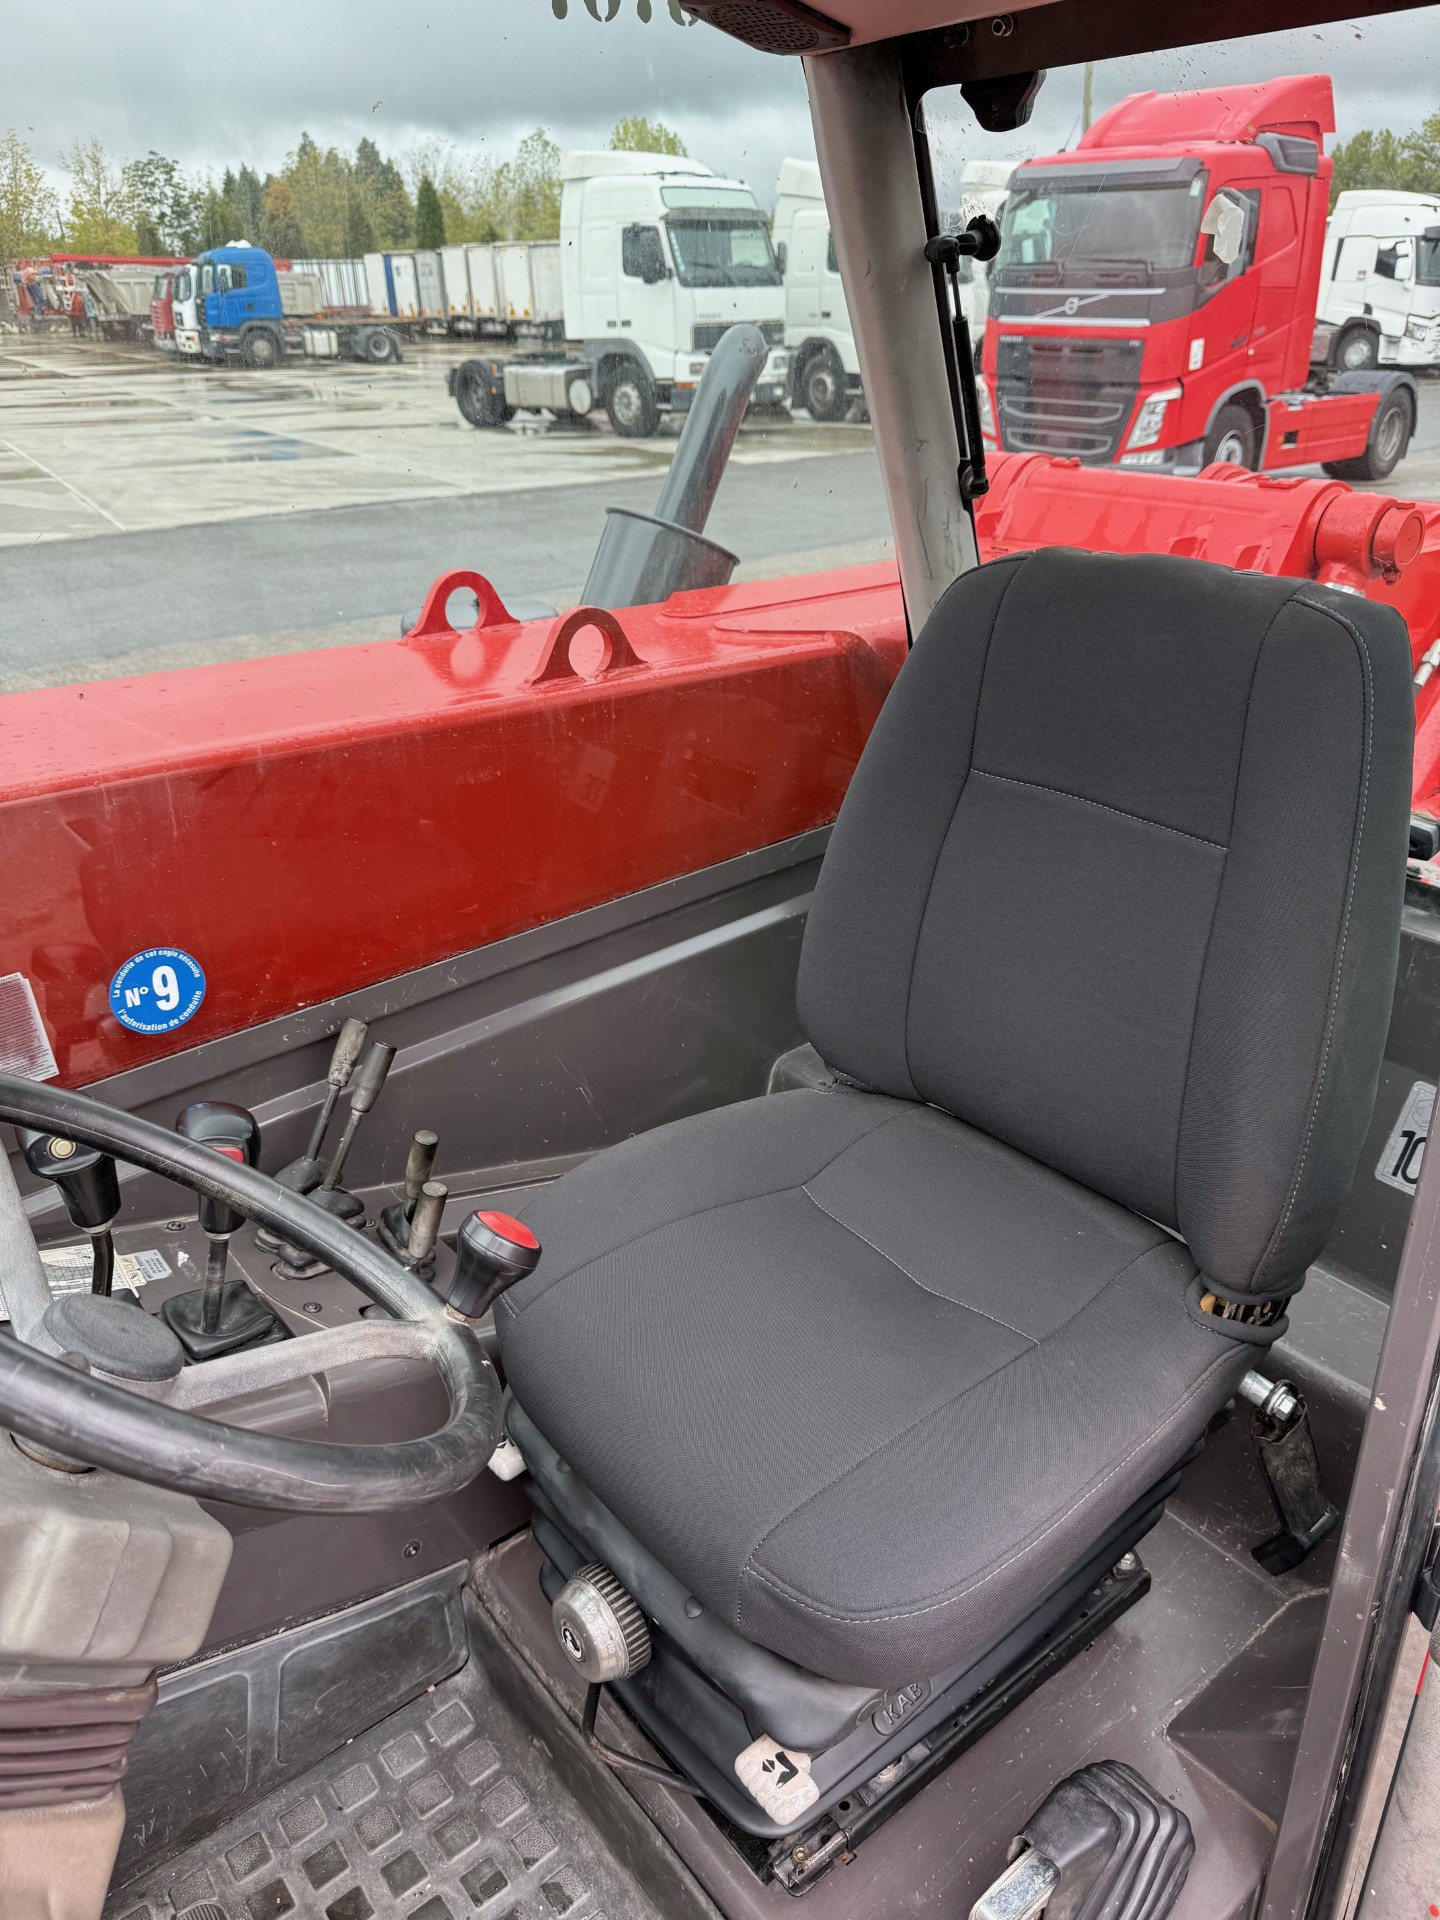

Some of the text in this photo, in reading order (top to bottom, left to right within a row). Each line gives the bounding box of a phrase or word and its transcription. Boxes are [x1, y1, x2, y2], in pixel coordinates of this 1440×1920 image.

[134, 954, 144, 963] de
[145, 950, 157, 958] cet
[158, 950, 178, 958] engin
[115, 962, 135, 988] conduite
[112, 989, 120, 998] La
[152, 965, 180, 1011] 9
[117, 990, 202, 1031] l'autorisation de conduite
[587, 1601, 598, 1614] 90
[883, 1682, 922, 1725] KAB
